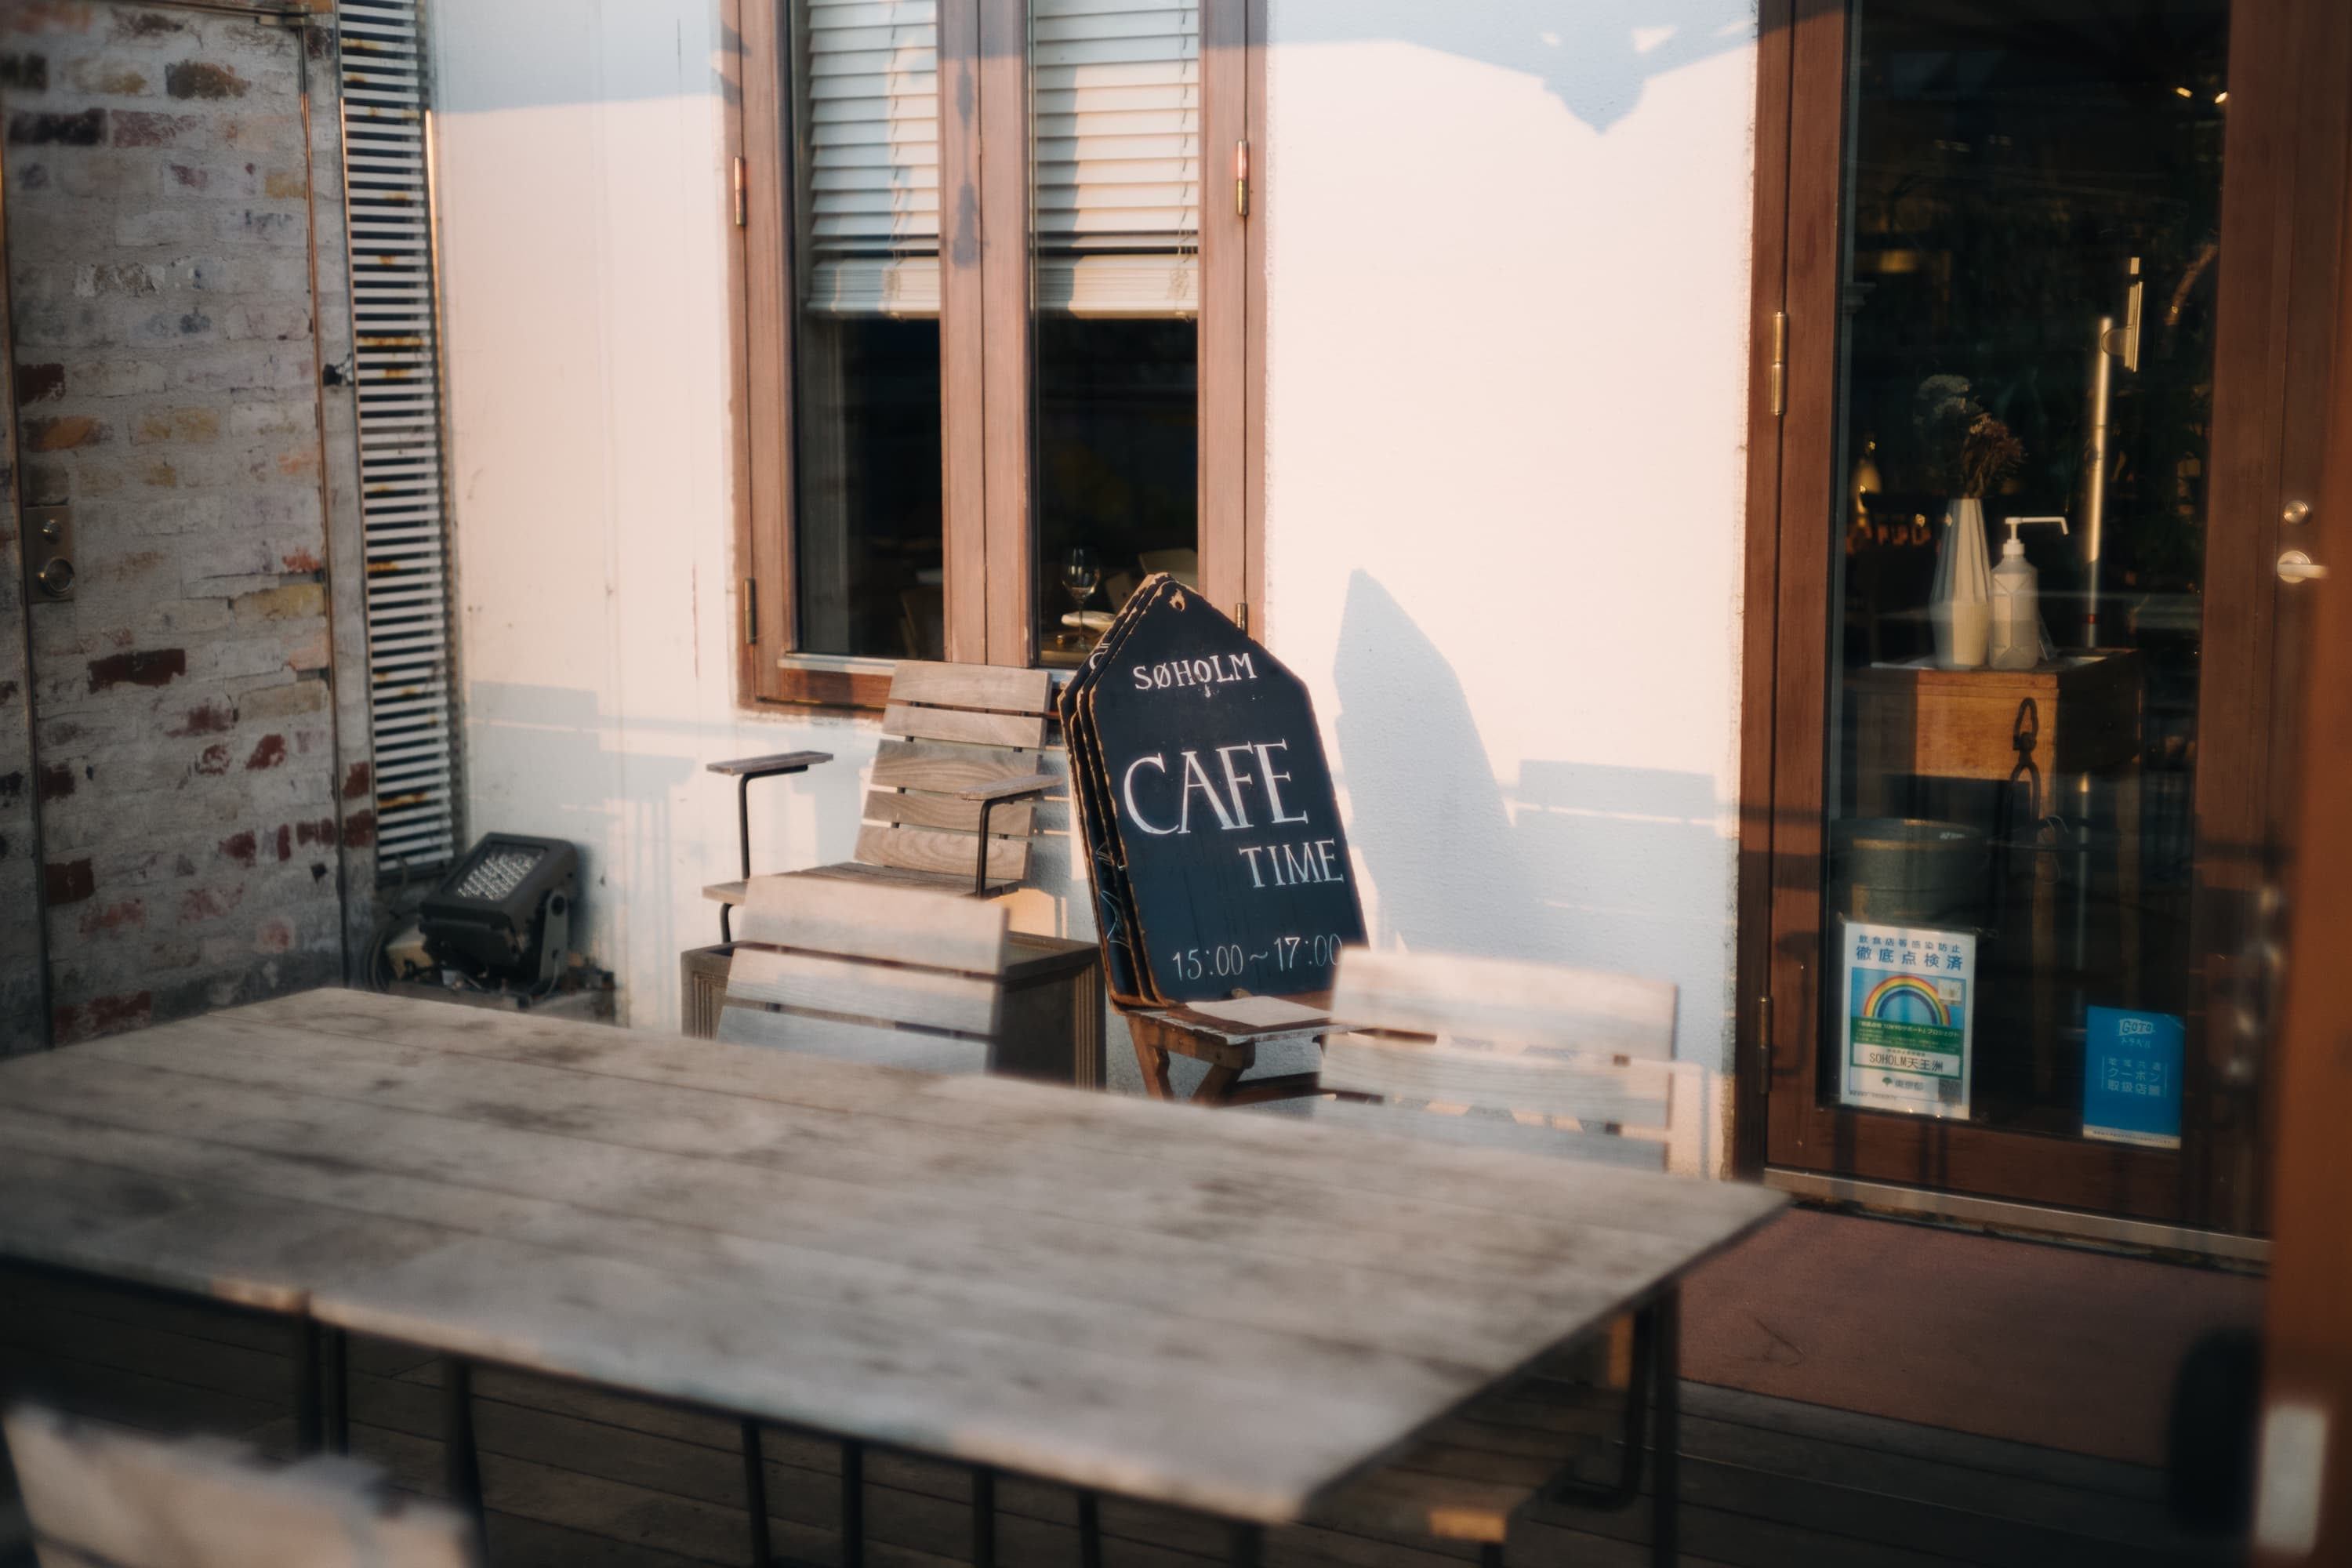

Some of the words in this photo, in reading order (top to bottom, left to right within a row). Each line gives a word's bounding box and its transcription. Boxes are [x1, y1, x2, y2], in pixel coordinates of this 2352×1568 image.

[1133, 652, 1258, 691] SØHOLM
[1123, 739, 1308, 835] CAFE
[1239, 838, 1344, 888] TIME
[1856, 945, 1963, 971] 徹底点検済
